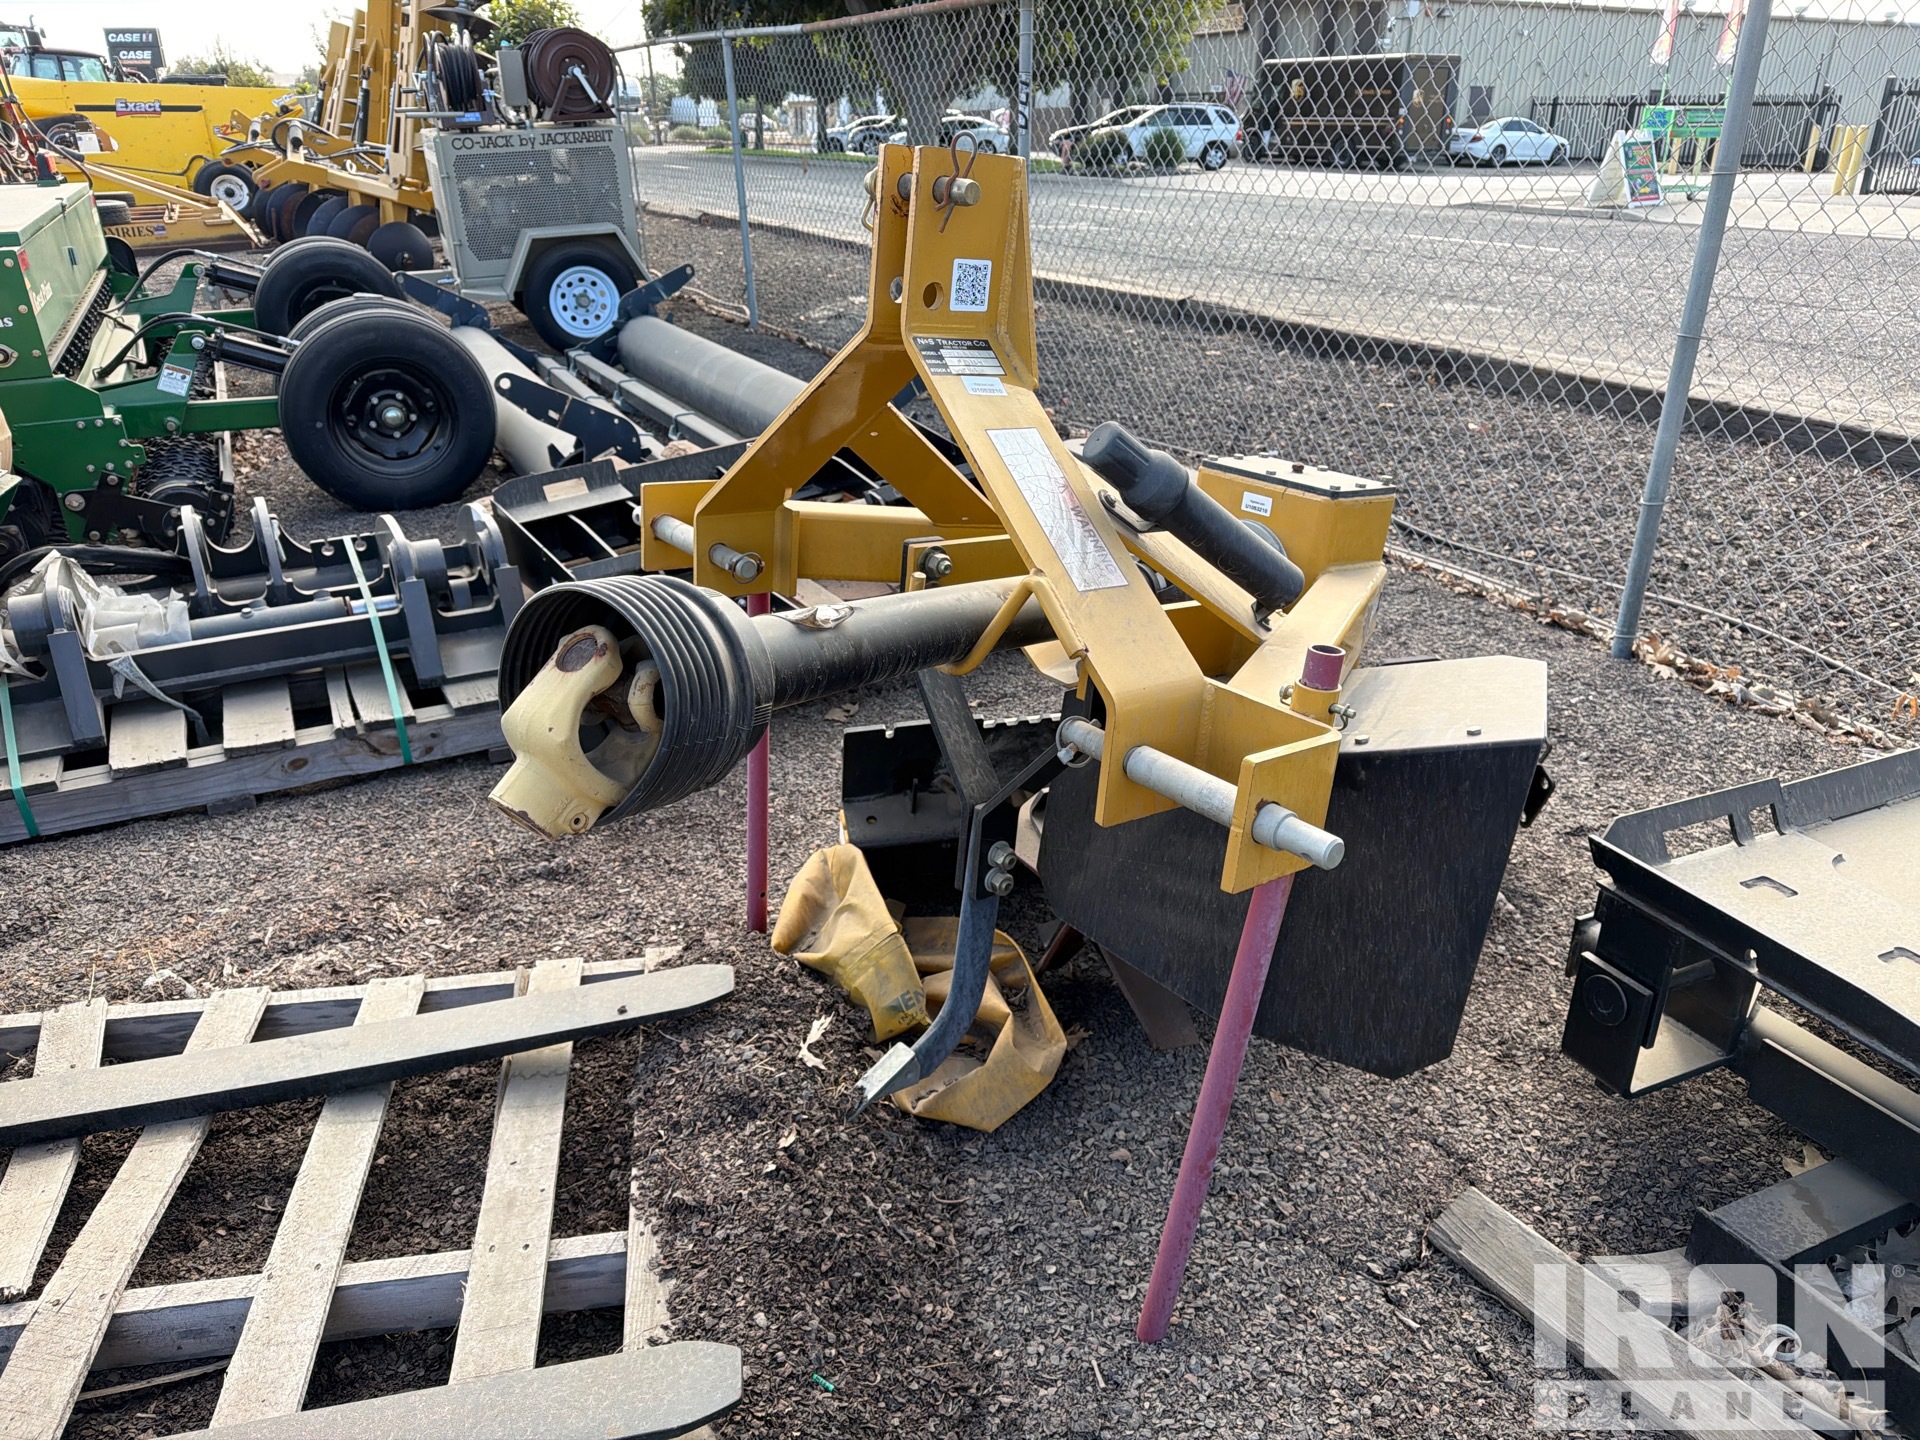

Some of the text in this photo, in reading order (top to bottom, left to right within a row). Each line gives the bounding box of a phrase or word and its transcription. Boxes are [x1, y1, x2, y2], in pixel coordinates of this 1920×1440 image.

[108, 33, 140, 42] CASE
[119, 50, 151, 59] CASE
[115, 98, 161, 111] Exact
[451, 130, 613, 150] CO-JACK by JACKRABBIT
[1070, 505, 1118, 576] WARNING
